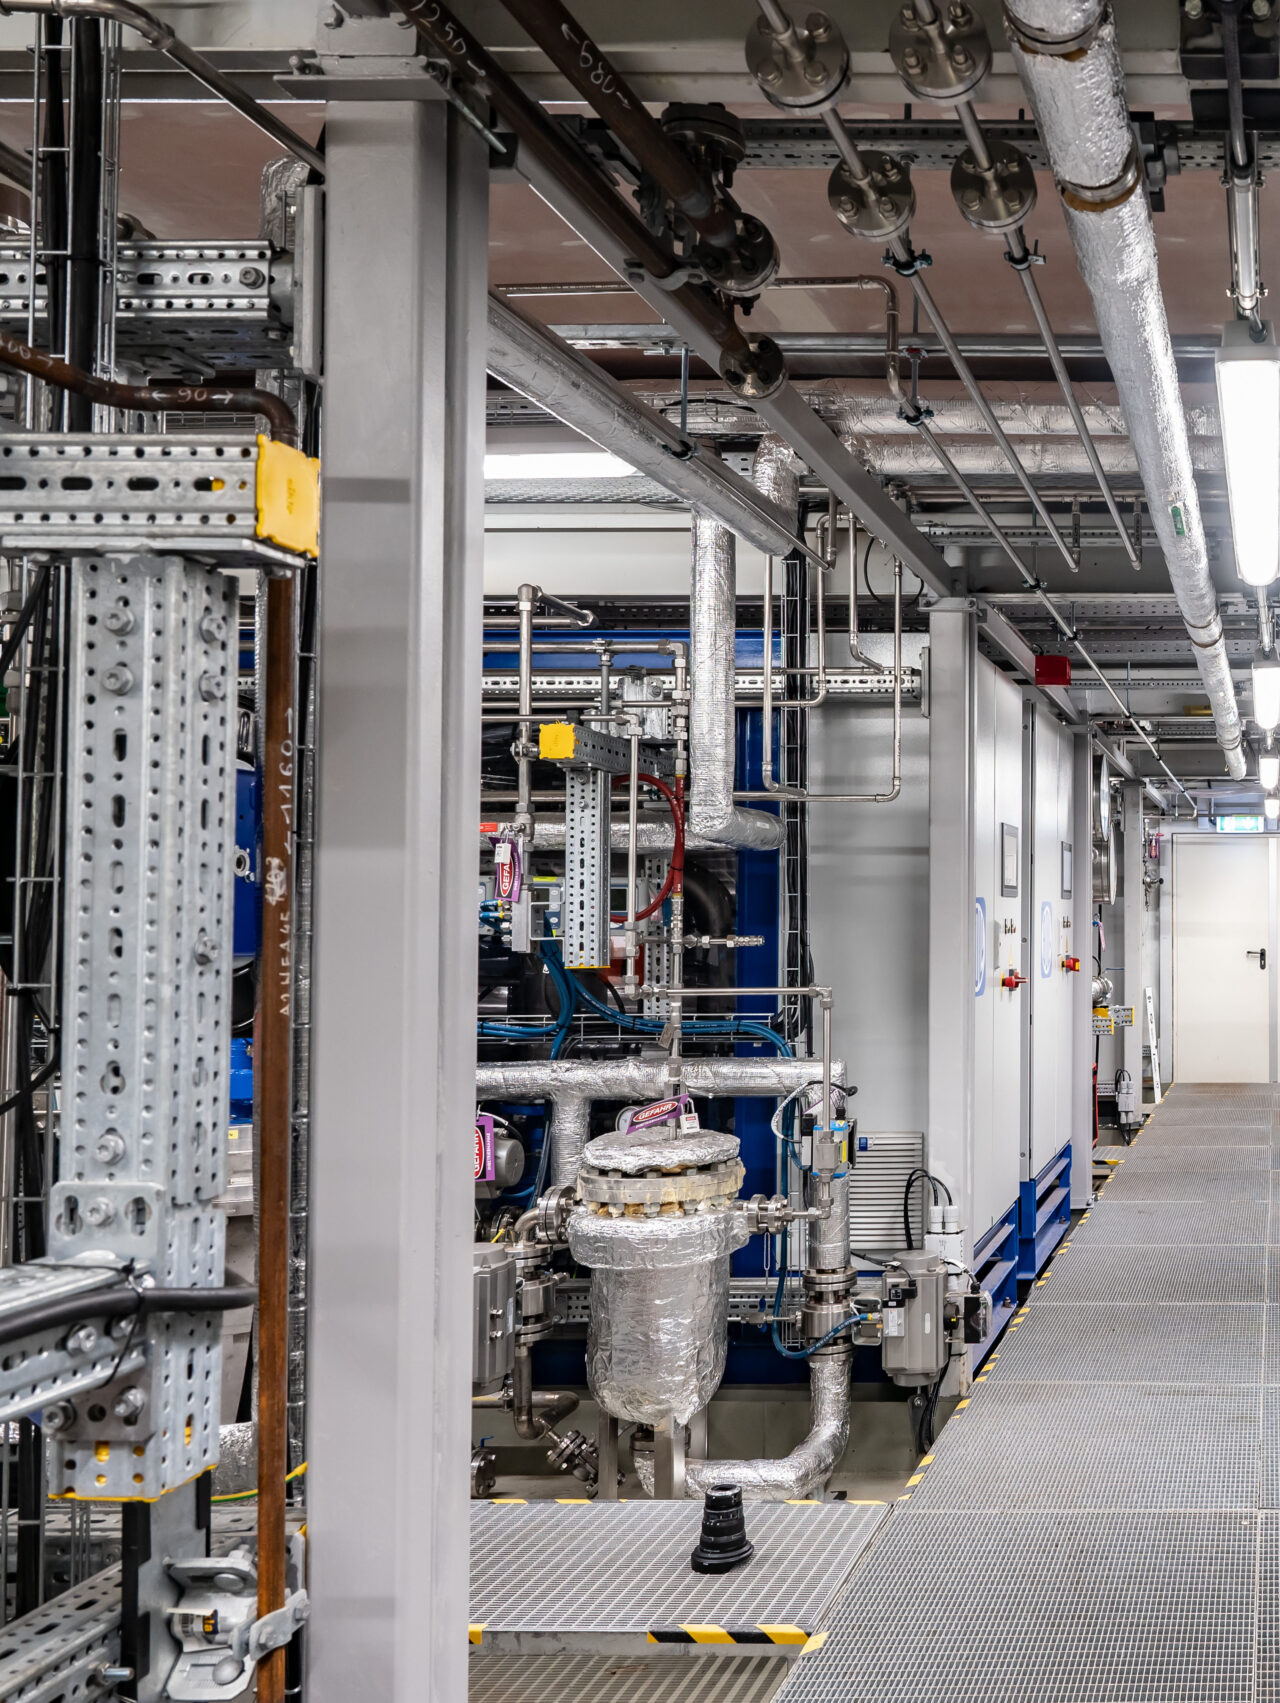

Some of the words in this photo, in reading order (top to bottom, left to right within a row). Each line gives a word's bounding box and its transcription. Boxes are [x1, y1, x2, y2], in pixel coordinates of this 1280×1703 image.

[177, 387, 208, 403] 90
[278, 739, 294, 825] 1160
[638, 1103, 673, 1120] GEFAHR
